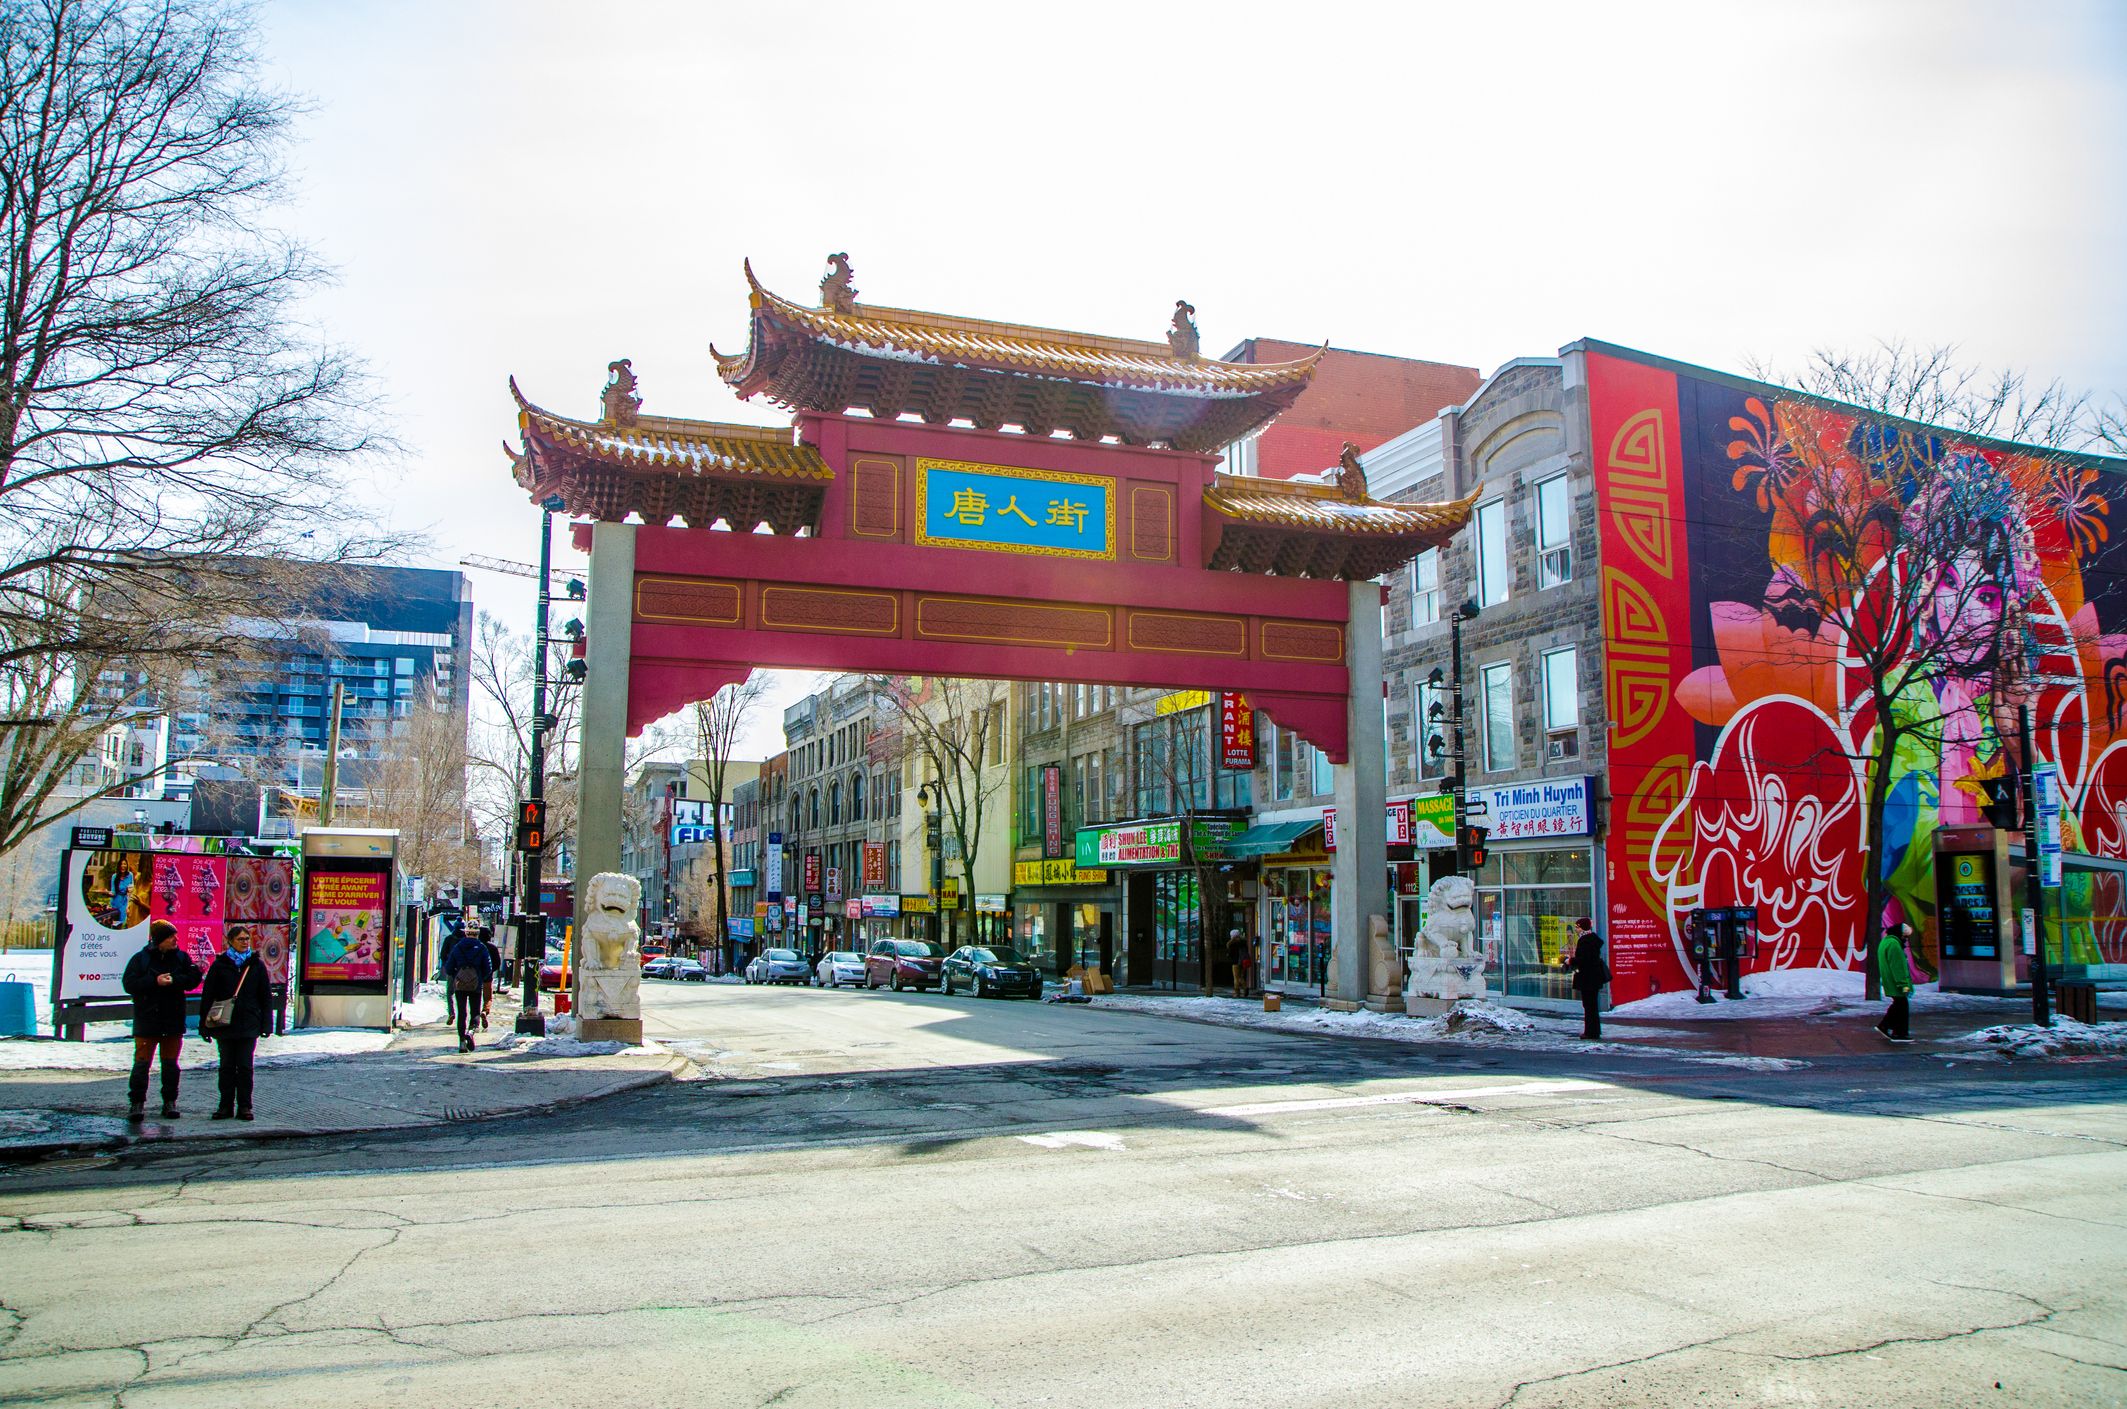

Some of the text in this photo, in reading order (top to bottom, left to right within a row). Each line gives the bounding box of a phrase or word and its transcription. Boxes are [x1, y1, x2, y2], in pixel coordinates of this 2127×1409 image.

[943, 487, 1089, 534] 唐人街
[1494, 783, 1583, 807] Tri Minh Huynh
[1417, 798, 1453, 815] MASSAGE
[1500, 804, 1578, 821] OPTICIEN DU QUARTIER
[1048, 793, 1058, 854] FUNG SHING
[1118, 831, 1147, 846] SHUN LEE
[1118, 846, 1160, 861] ALIMENTATION
[1161, 847, 1166, 858] &
[1474, 851, 1483, 864] 0
[312, 875, 377, 884] VOTRE ÉPICERIE
[1079, 870, 1107, 880] FUNG SHING
[312, 883, 340, 891] LIVRÉE
[311, 890, 380, 899] MÊME D'ARRIVER
[81, 933, 96, 941] 100
[80, 942, 103, 950] d'étés
